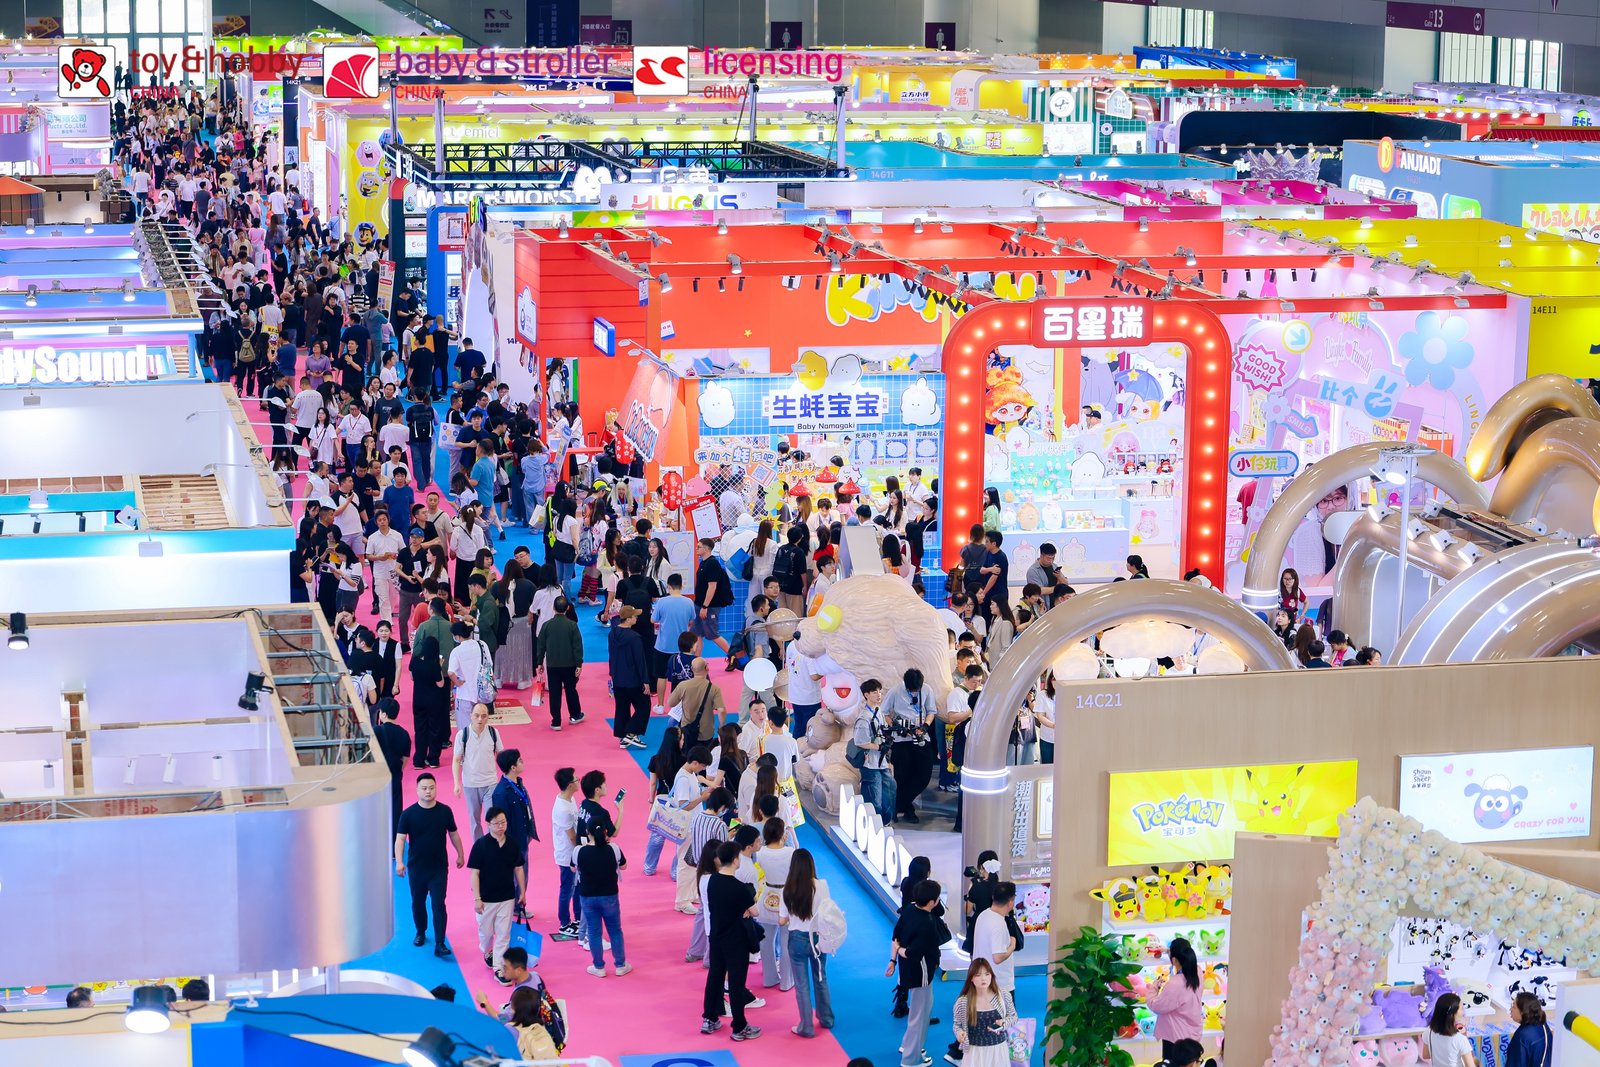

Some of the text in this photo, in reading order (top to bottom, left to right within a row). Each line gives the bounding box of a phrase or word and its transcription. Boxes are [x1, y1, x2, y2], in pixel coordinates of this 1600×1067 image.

[1434, 9, 1444, 28] 13
[871, 170, 894, 179] 14G11
[1530, 209, 1600, 229] クレヨンしん
[1532, 305, 1557, 315] 14E11
[1043, 305, 1144, 342] 百星瑞
[1248, 353, 1277, 375] GOOD
[1243, 364, 1272, 384] WISH!
[1320, 379, 1359, 407] 比个
[772, 392, 879, 420] 生蚝宝宝
[1236, 455, 1289, 472] 小伶玩具
[1076, 693, 1122, 709] 14C21
[1513, 815, 1585, 829] CRAZY FOR YOU
